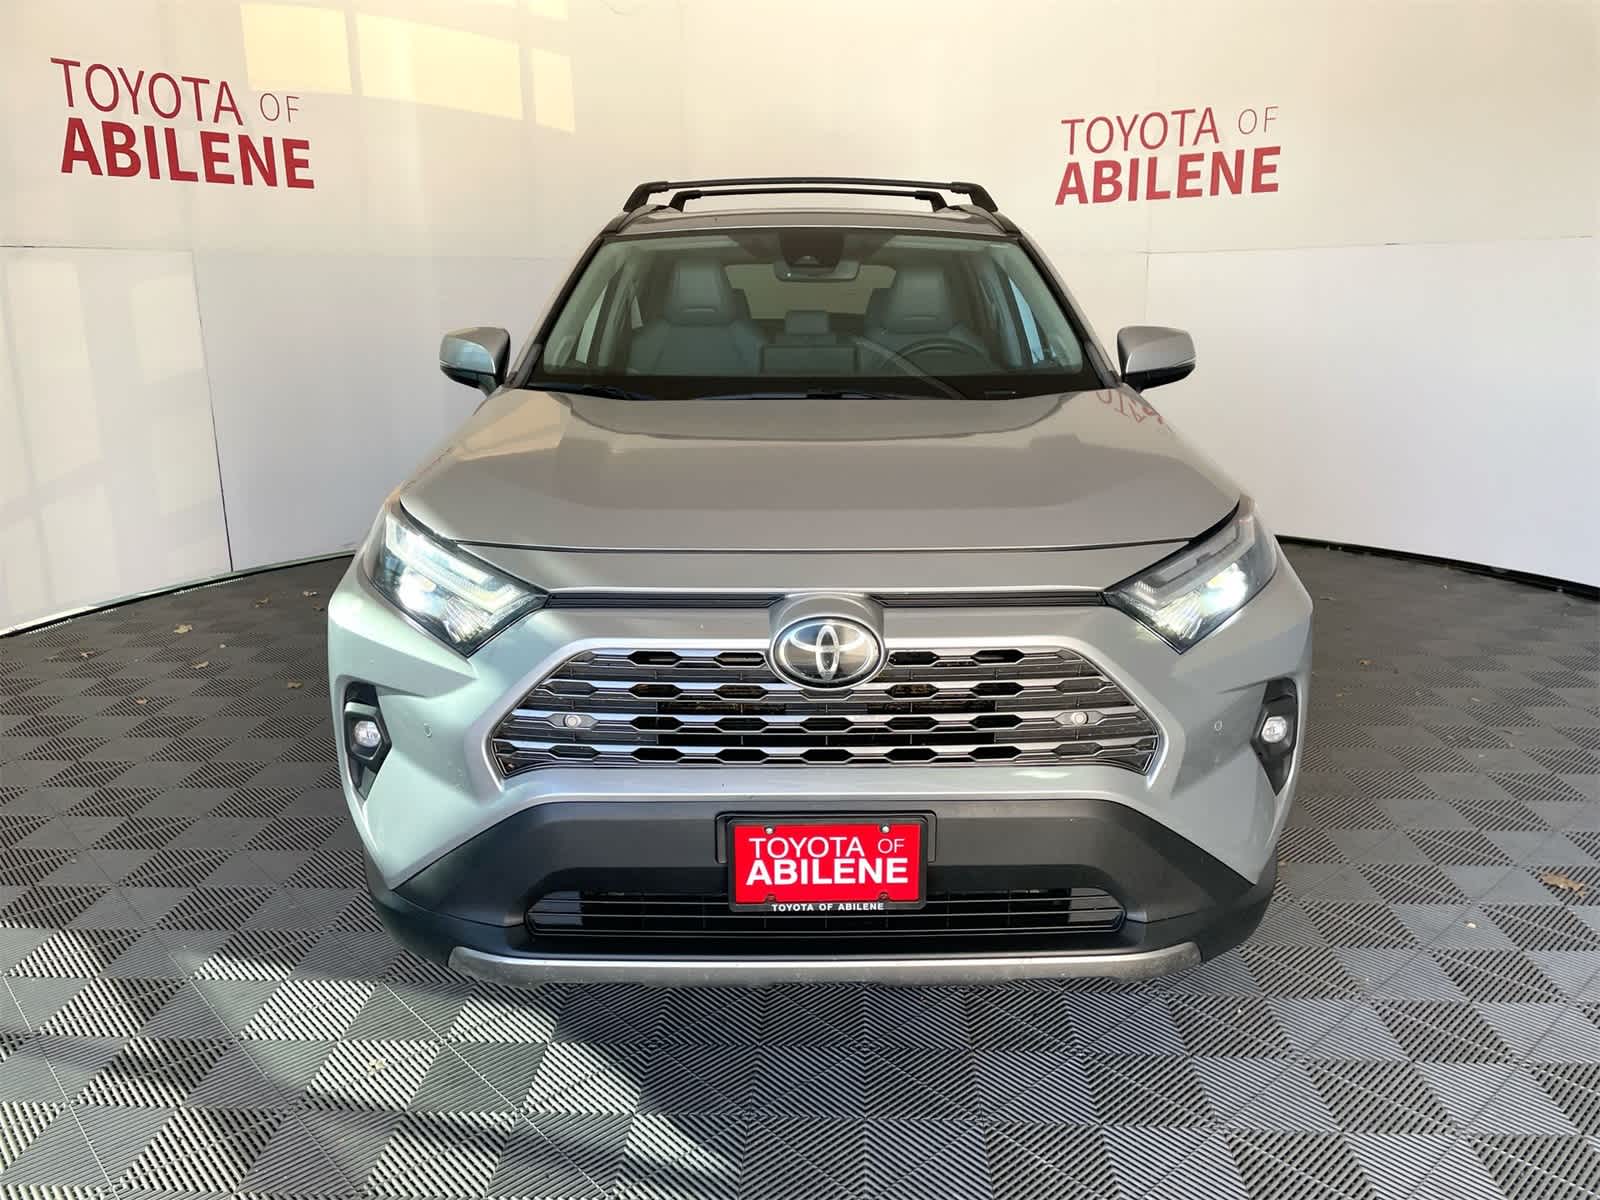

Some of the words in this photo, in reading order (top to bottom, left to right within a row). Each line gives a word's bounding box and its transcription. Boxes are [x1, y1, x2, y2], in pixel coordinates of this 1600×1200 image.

[50, 57, 244, 126] TOYOTA
[259, 92, 300, 123] OF
[60, 116, 316, 190] ABILENE
[1061, 106, 1220, 156] TOYOTA
[1238, 105, 1279, 135] OF
[1055, 145, 1281, 206] ABILENE
[746, 857, 909, 886] ABILENE
[748, 836, 865, 859] TOYOTA
[877, 838, 905, 854] OF
[771, 903, 814, 912] TOYOTA
[818, 902, 833, 911] OF
[837, 902, 885, 911] ABILENE
